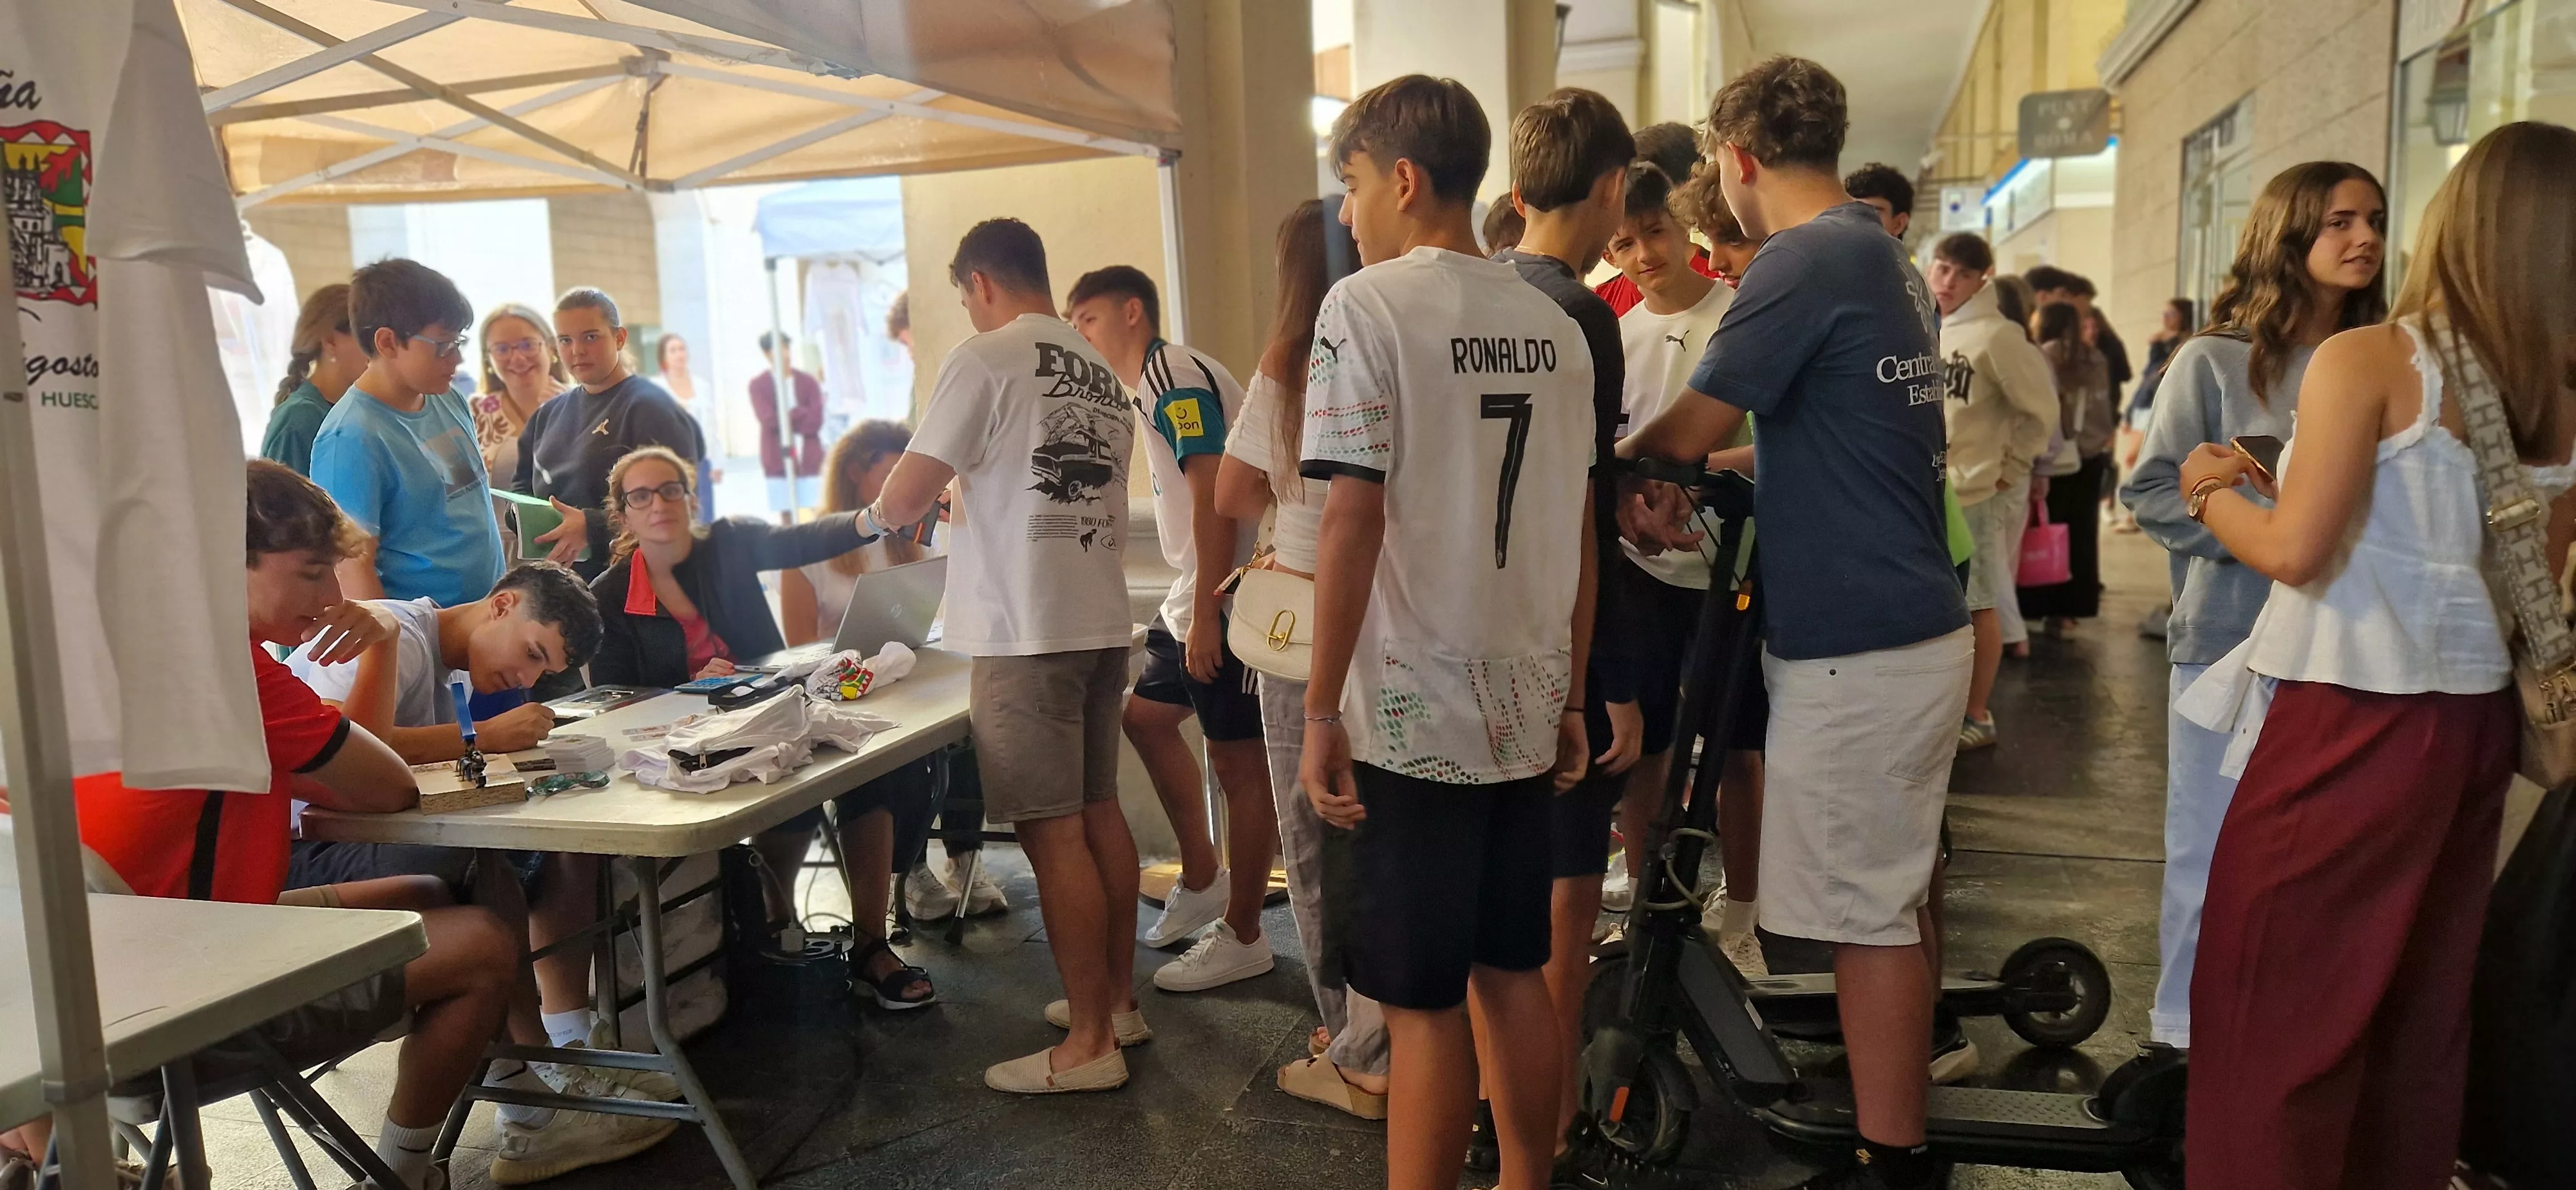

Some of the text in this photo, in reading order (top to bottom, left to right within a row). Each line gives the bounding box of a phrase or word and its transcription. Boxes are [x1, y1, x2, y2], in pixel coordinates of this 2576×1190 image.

[23, 353, 99, 386] gosto
[1034, 342, 1132, 411] FORD
[1450, 337, 1557, 375] RONALDO
[1481, 393, 1533, 570] 7
